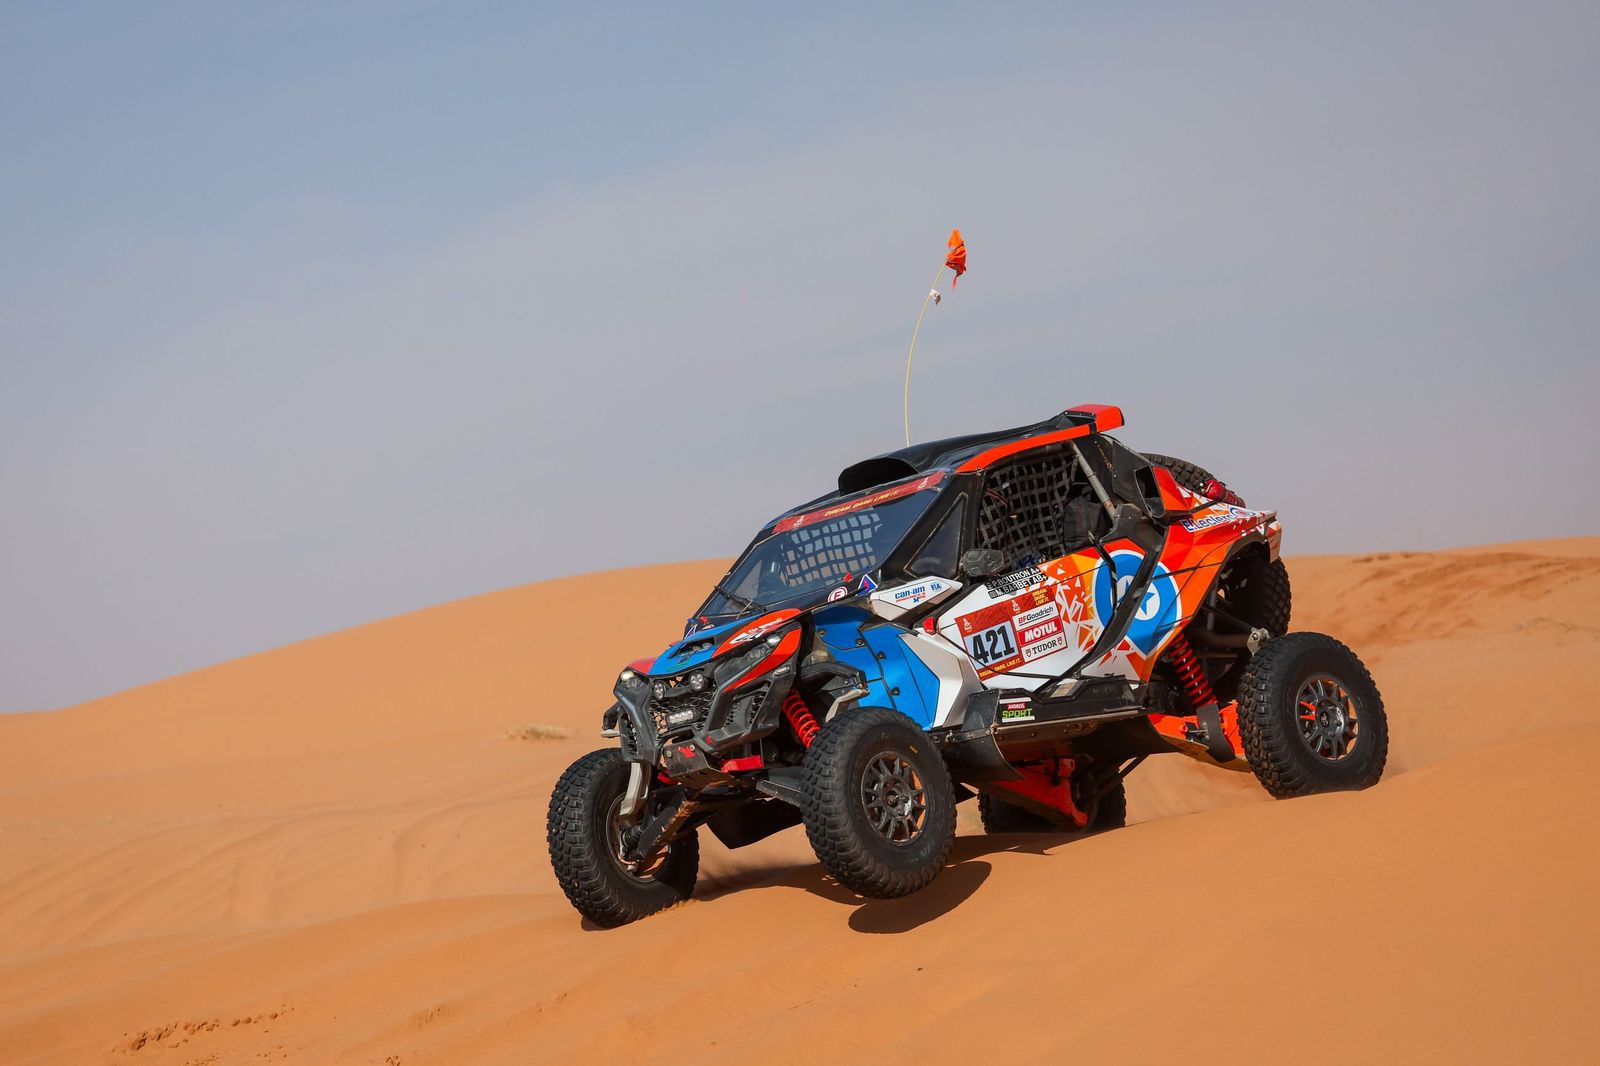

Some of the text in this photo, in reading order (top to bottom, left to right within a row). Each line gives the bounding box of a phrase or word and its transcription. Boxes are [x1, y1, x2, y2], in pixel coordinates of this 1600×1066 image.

[930, 583, 942, 592] FIA
[1018, 606, 1054, 622] BFGoodrich
[1025, 621, 1057, 643] MOTUL
[972, 625, 1015, 664] 421
[1032, 639, 1058, 655] TUDOR
[1002, 708, 1033, 719] SPORT
